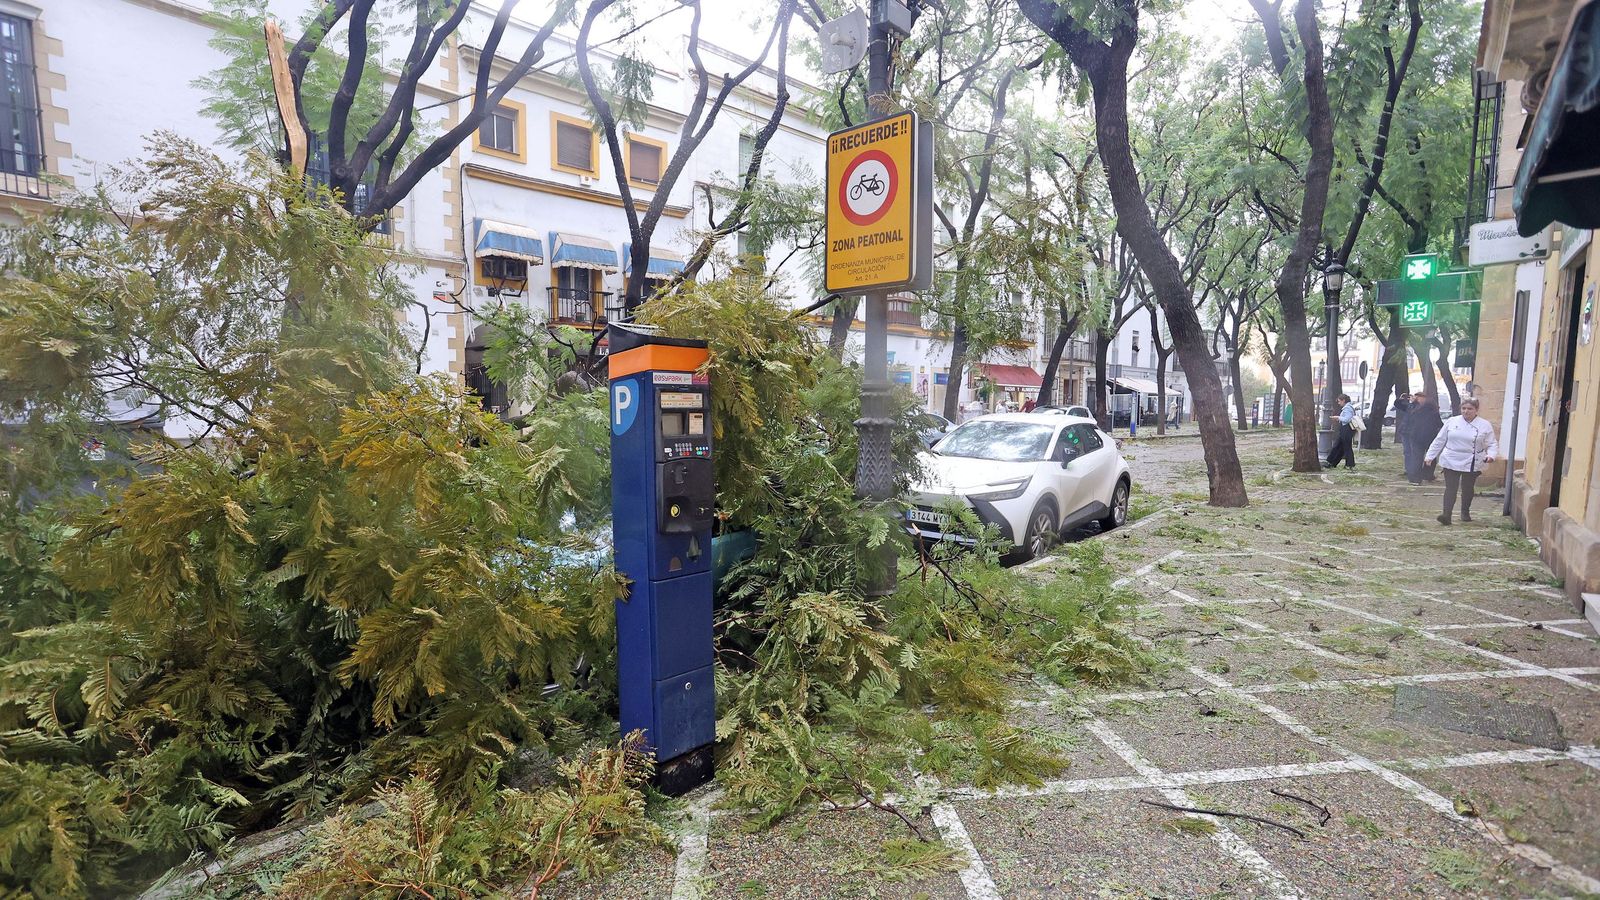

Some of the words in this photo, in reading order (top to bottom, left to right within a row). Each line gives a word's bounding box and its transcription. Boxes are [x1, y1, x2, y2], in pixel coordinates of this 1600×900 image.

[832, 237, 855, 252] ZONA
[857, 229, 903, 248] PEATONAL
[830, 260, 864, 271] ORDENANZA
[865, 255, 895, 265] MUNICIPAL
[615, 385, 631, 425] P
[911, 511, 930, 521] 3144
